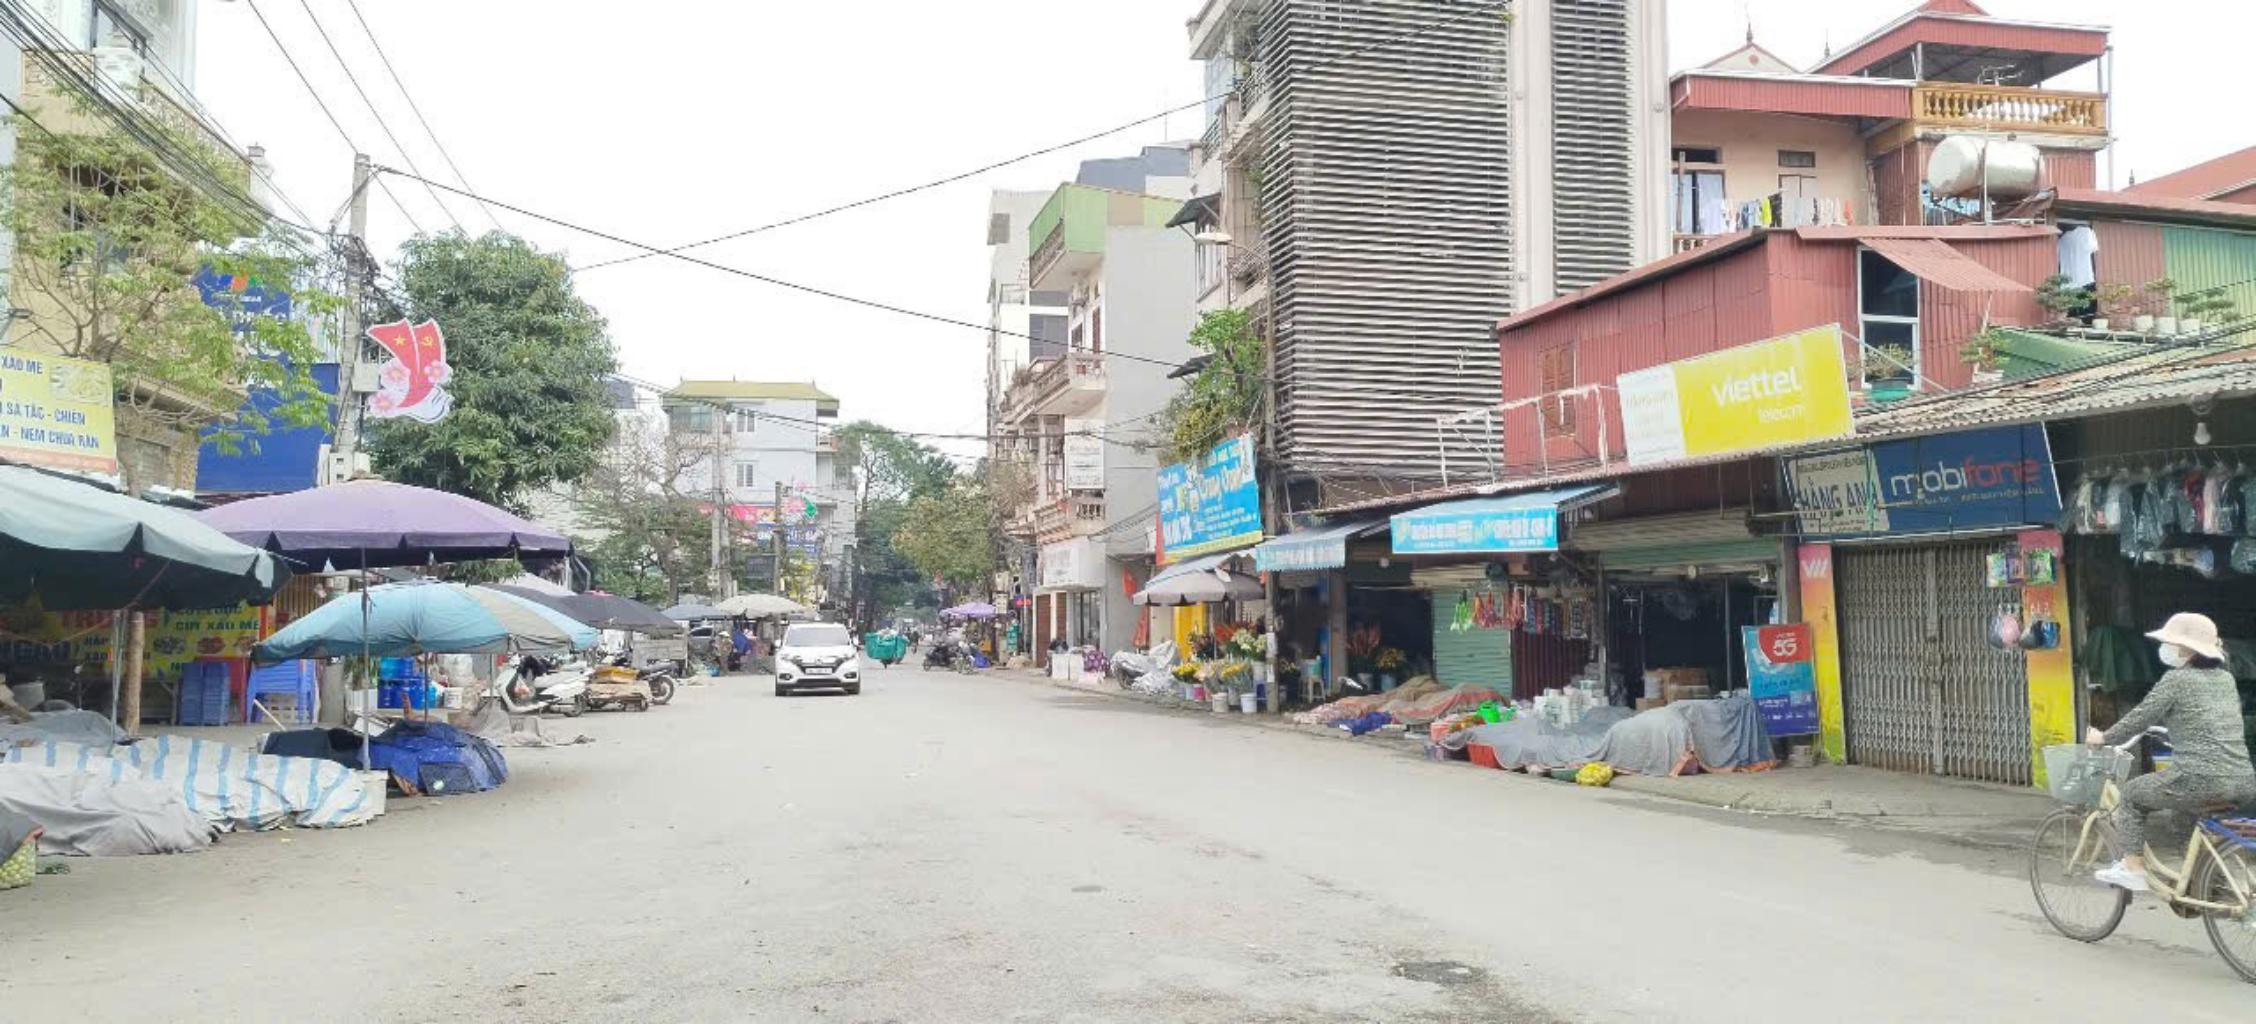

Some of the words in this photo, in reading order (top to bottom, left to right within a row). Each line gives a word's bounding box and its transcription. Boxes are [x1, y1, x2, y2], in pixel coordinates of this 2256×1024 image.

[1711, 366, 1803, 408] viettel
[1890, 454, 2042, 497] mobifone
[1773, 637, 1798, 656] 5G
